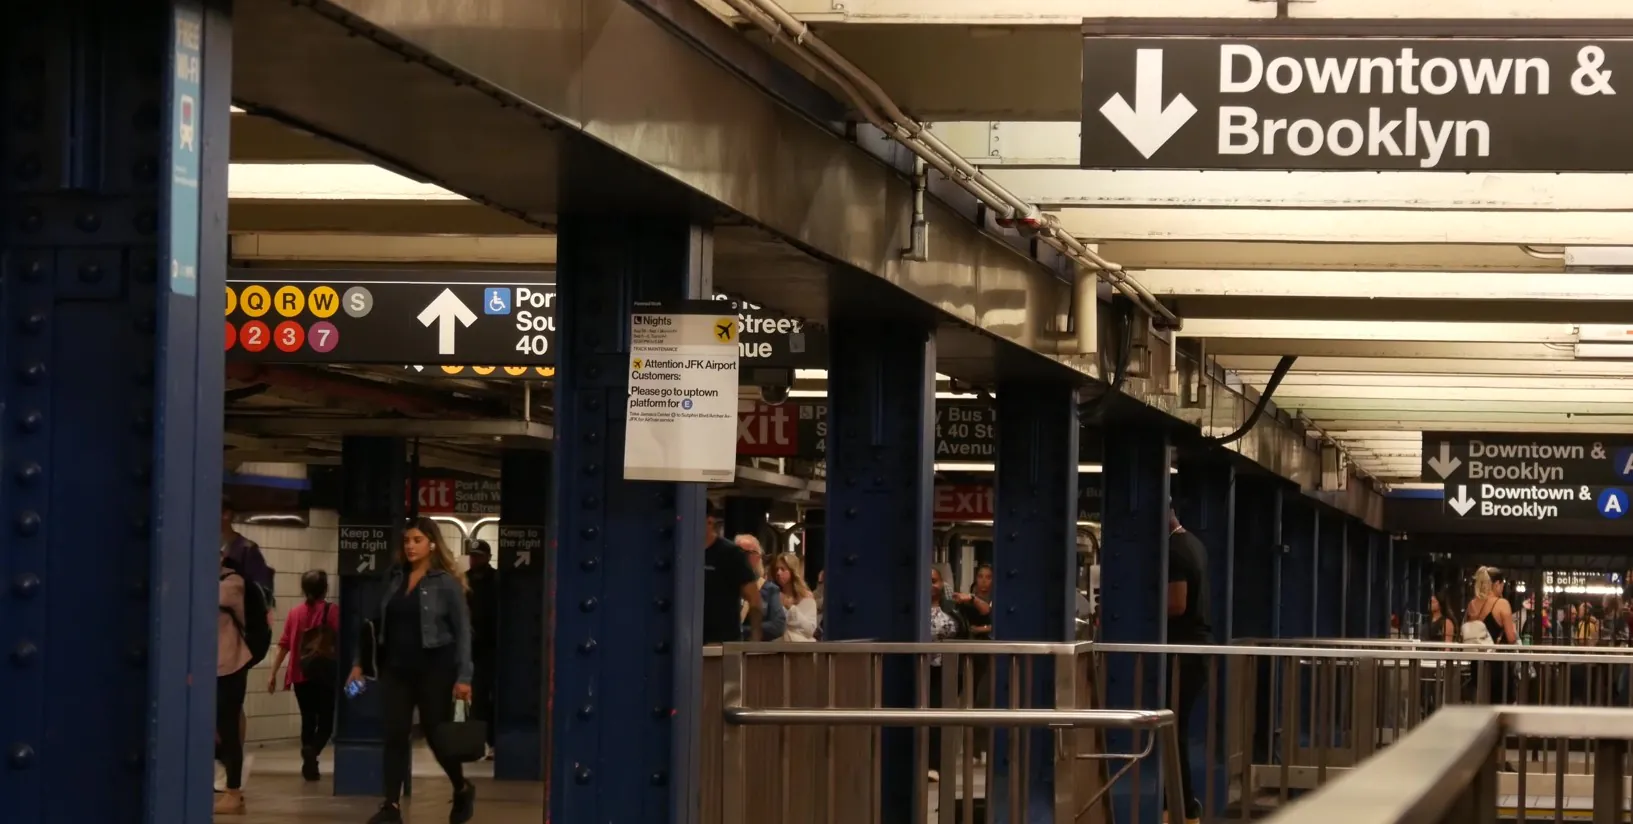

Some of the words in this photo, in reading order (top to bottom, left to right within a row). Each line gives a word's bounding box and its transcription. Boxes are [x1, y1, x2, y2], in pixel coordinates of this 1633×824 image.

[1219, 44, 1550, 95] Downtown
[1570, 45, 1616, 95] &
[1218, 106, 1490, 168] Brooklyn
[247, 292, 263, 310] Q
[282, 293, 296, 310] R
[313, 294, 334, 311] W
[350, 293, 365, 311] S
[516, 287, 556, 308] Por
[643, 316, 672, 327] Nights
[248, 326, 262, 345] 2
[282, 328, 296, 345] 3
[317, 329, 330, 347] 7
[515, 335, 548, 355] 40
[644, 359, 684, 369] Attention
[685, 360, 704, 370] JFK
[705, 360, 736, 372] Airport
[631, 370, 682, 381] Customers:
[630, 385, 660, 397] Please
[661, 389, 672, 398] go
[673, 387, 683, 397] to
[683, 389, 719, 399] uptown
[629, 398, 667, 409] platform
[667, 398, 680, 409] for
[948, 407, 982, 422] Bus
[948, 425, 969, 438] 40
[815, 439, 826, 453] 4
[1469, 440, 1584, 459] Downtown
[1591, 441, 1606, 459] &
[1468, 461, 1564, 483] Brooklyn
[455, 480, 478, 491] Port
[1481, 484, 1574, 500] Downtown
[1579, 485, 1592, 500] &
[455, 490, 488, 501] South
[455, 502, 468, 512] 40
[1481, 501, 1558, 519] Brooklyn
[1604, 494, 1622, 512] A
[341, 527, 370, 540] Keep
[372, 528, 384, 538] to
[501, 528, 525, 539] Keep
[528, 528, 538, 537] to
[341, 540, 358, 549] the
[361, 540, 387, 552] right
[500, 539, 515, 547] the
[518, 538, 541, 549] right
